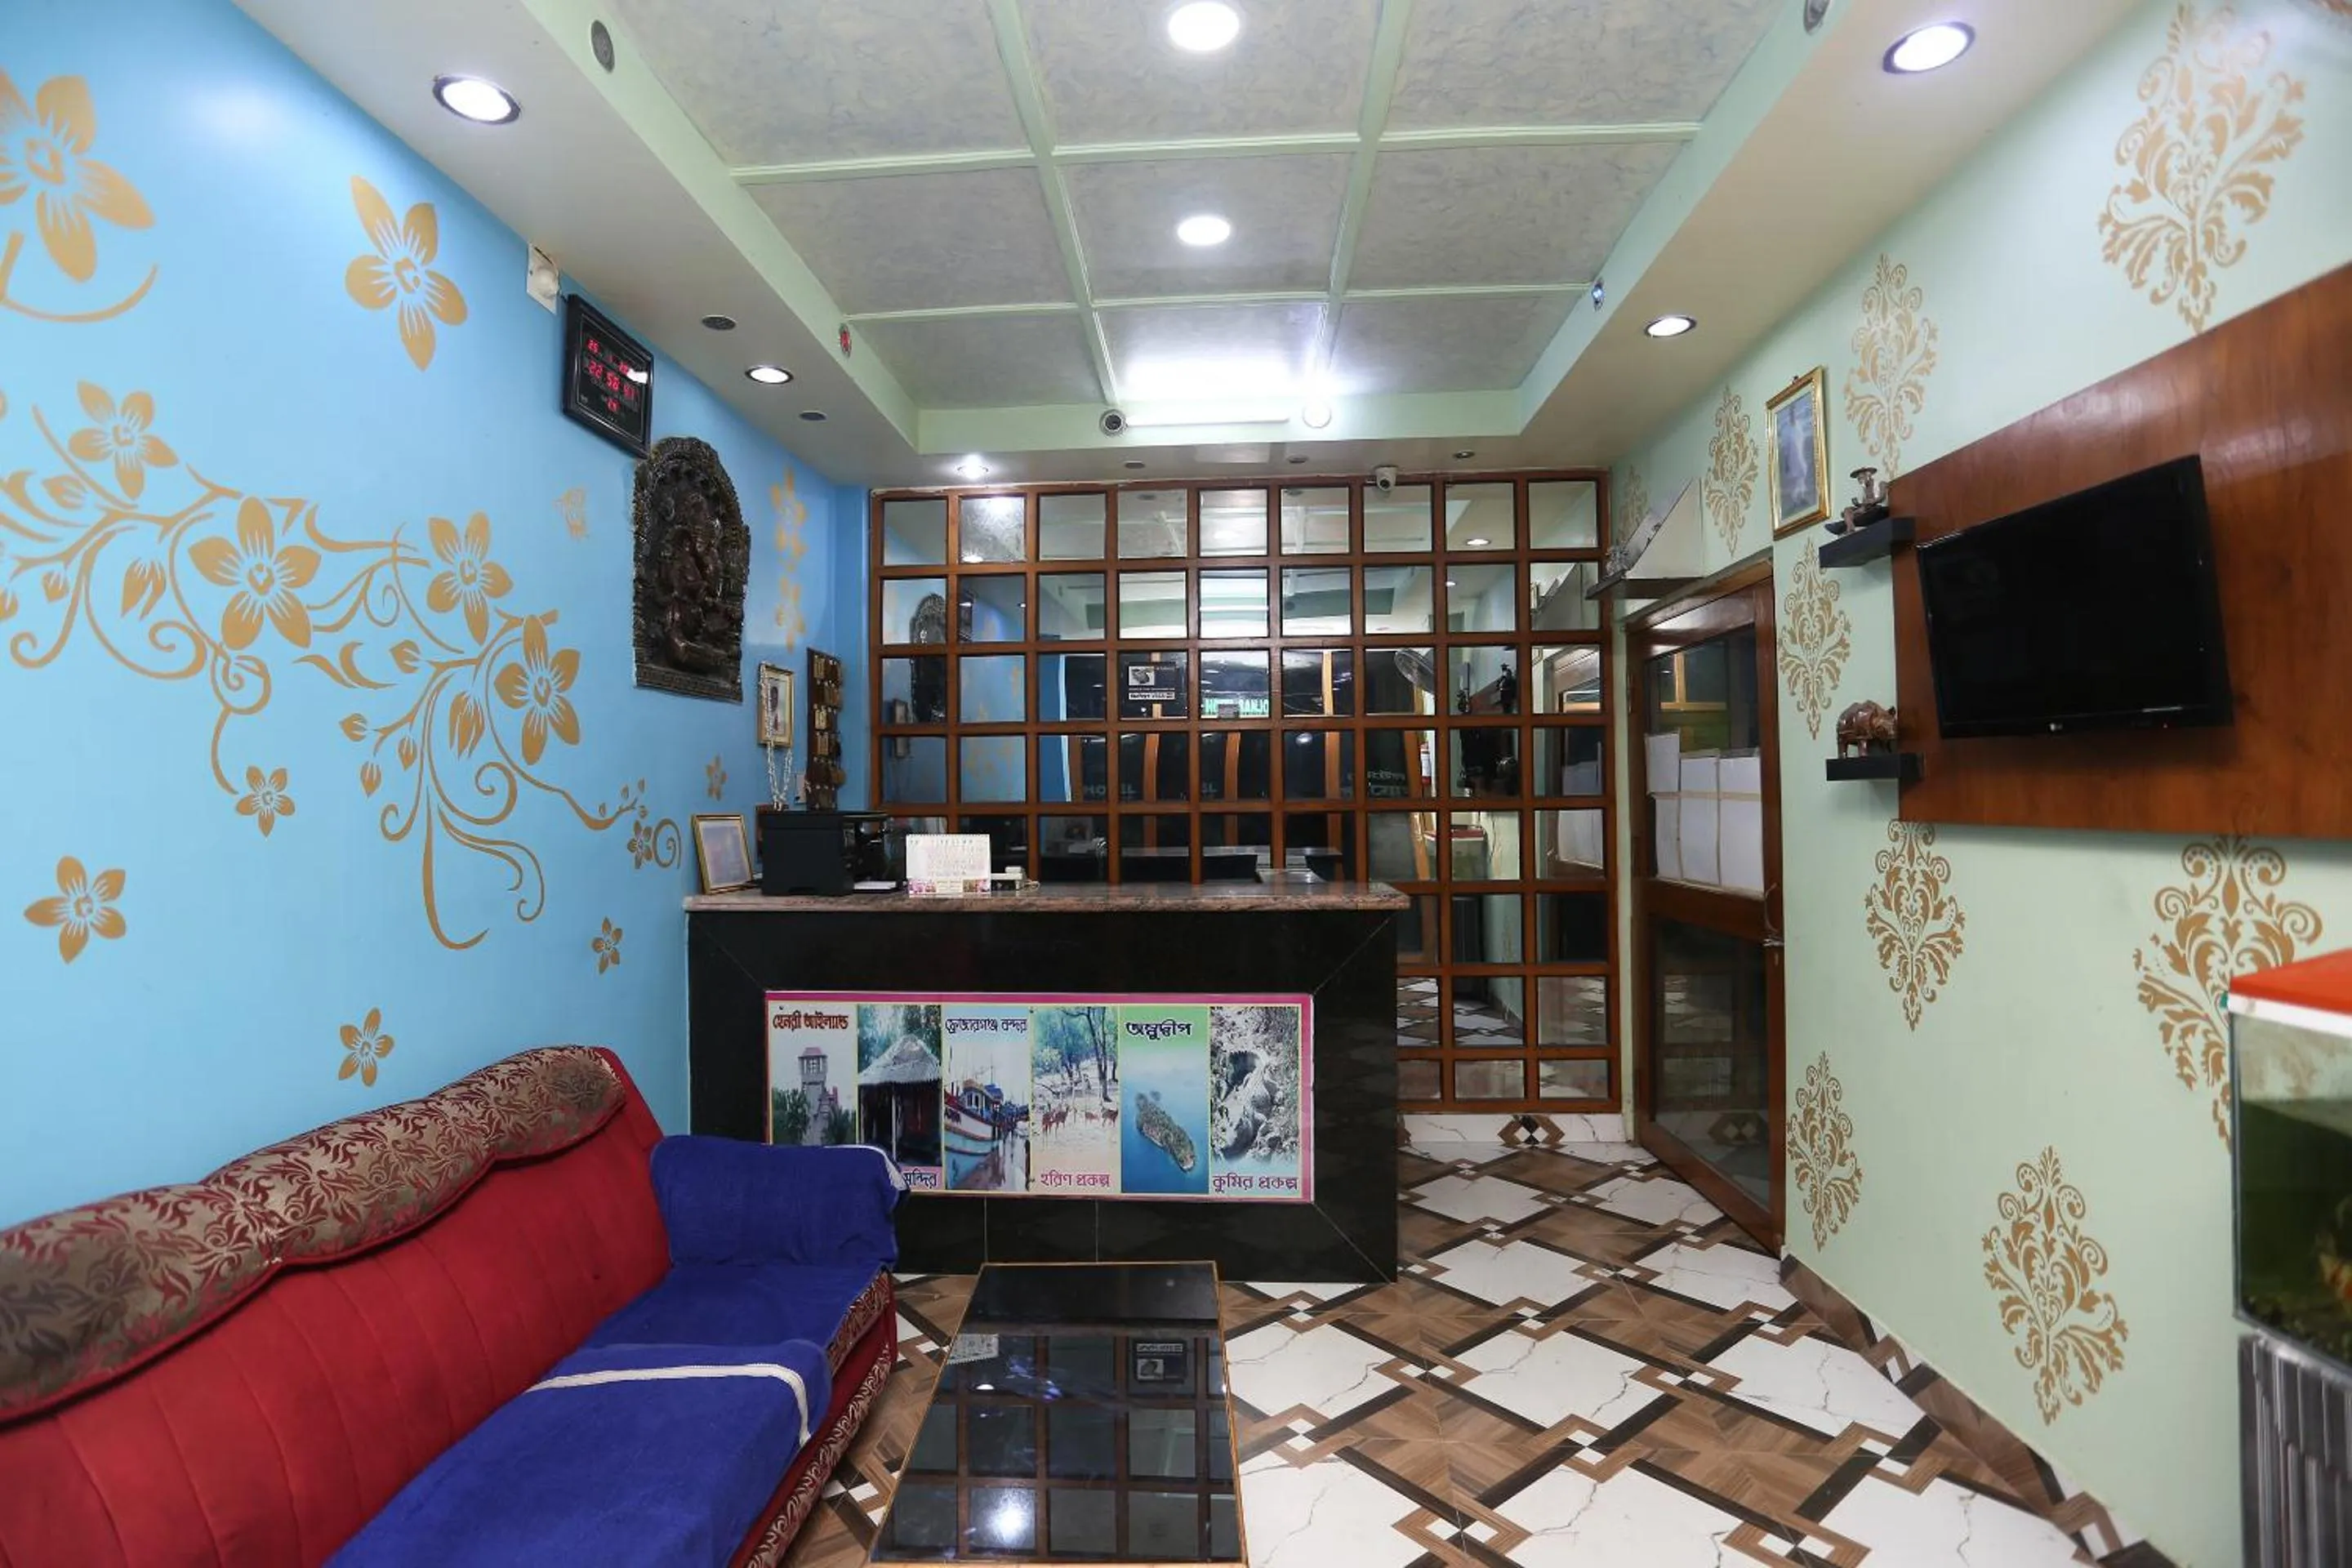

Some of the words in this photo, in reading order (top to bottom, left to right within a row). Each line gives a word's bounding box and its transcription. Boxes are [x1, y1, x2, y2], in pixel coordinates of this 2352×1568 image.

[1000, 1018, 1027, 1034] বন্দর
[1040, 1170, 1072, 1188] হরিণ
[1212, 1172, 1254, 1193] কুমির
